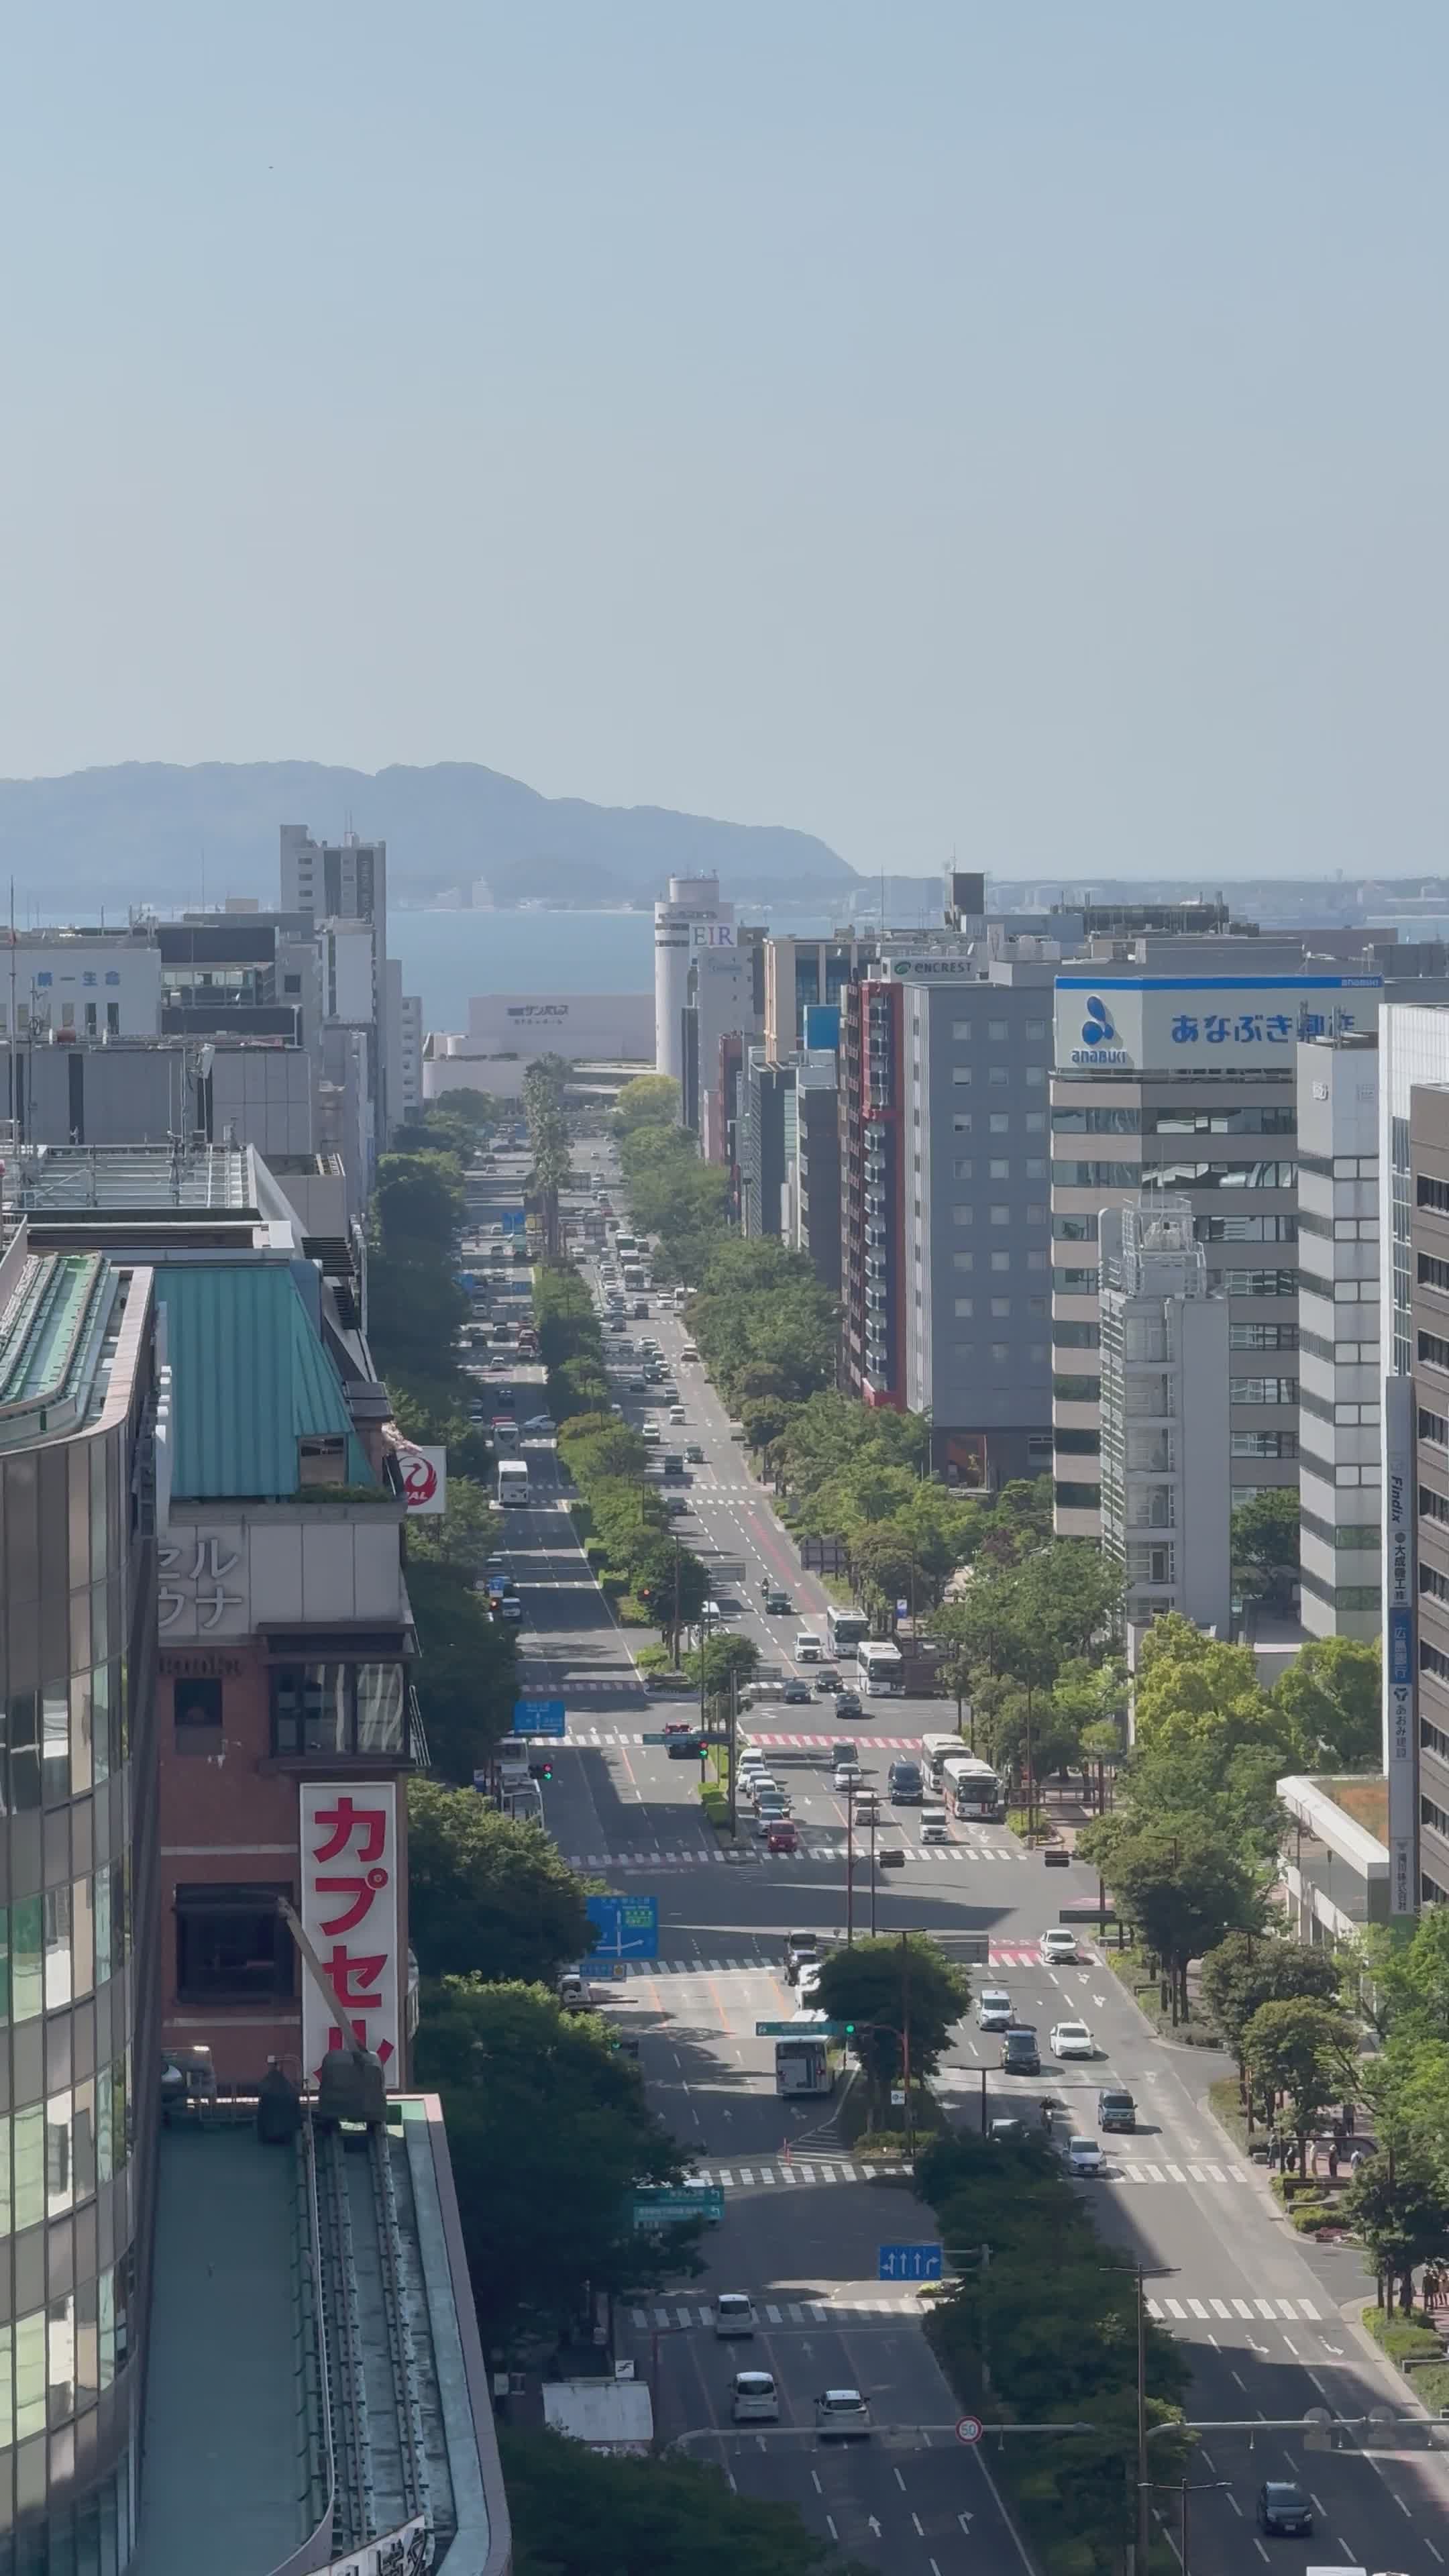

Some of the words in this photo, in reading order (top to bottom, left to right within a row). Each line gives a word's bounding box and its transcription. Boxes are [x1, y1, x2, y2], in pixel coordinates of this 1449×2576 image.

[692, 926, 734, 945] EIR
[1391, 1475, 1403, 1523] Findix
[961, 2424, 977, 2436] 50
